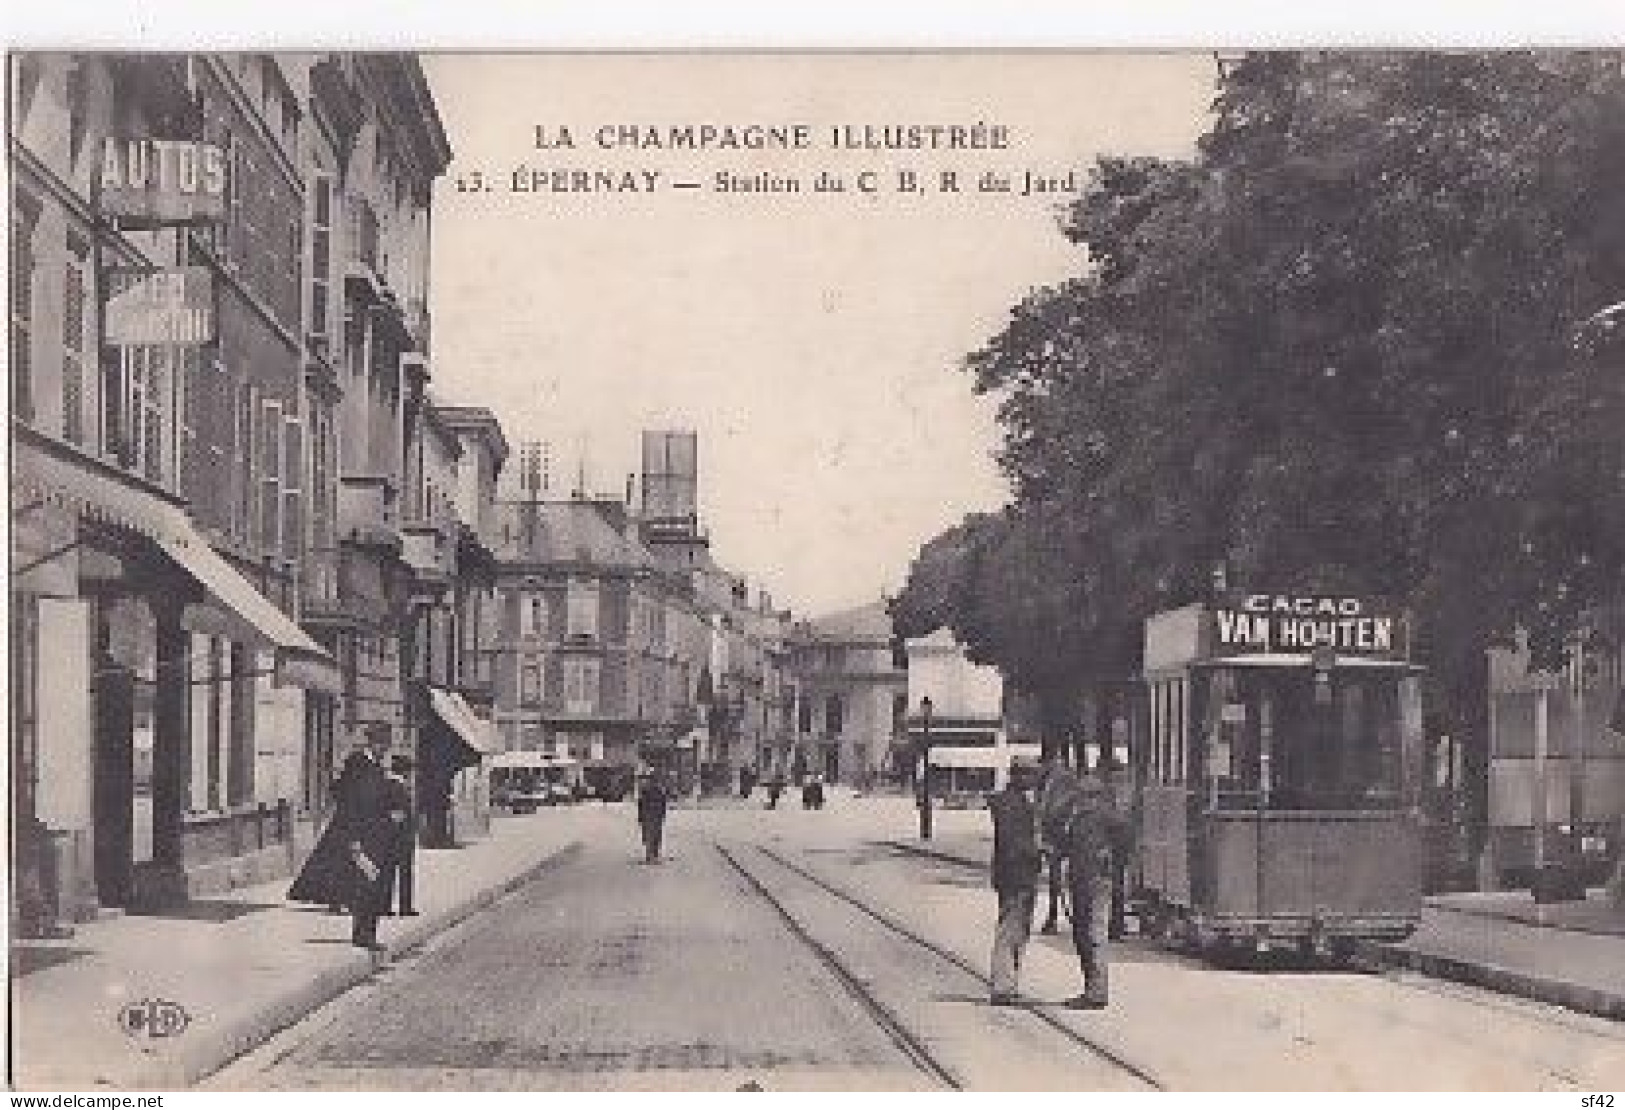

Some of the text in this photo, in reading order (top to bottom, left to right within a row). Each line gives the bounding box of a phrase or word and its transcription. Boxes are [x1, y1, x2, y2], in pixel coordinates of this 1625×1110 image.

[101, 137, 224, 193] AUTOS
[1245, 594, 1360, 615] CACAO
[1216, 610, 1270, 644] VAN
